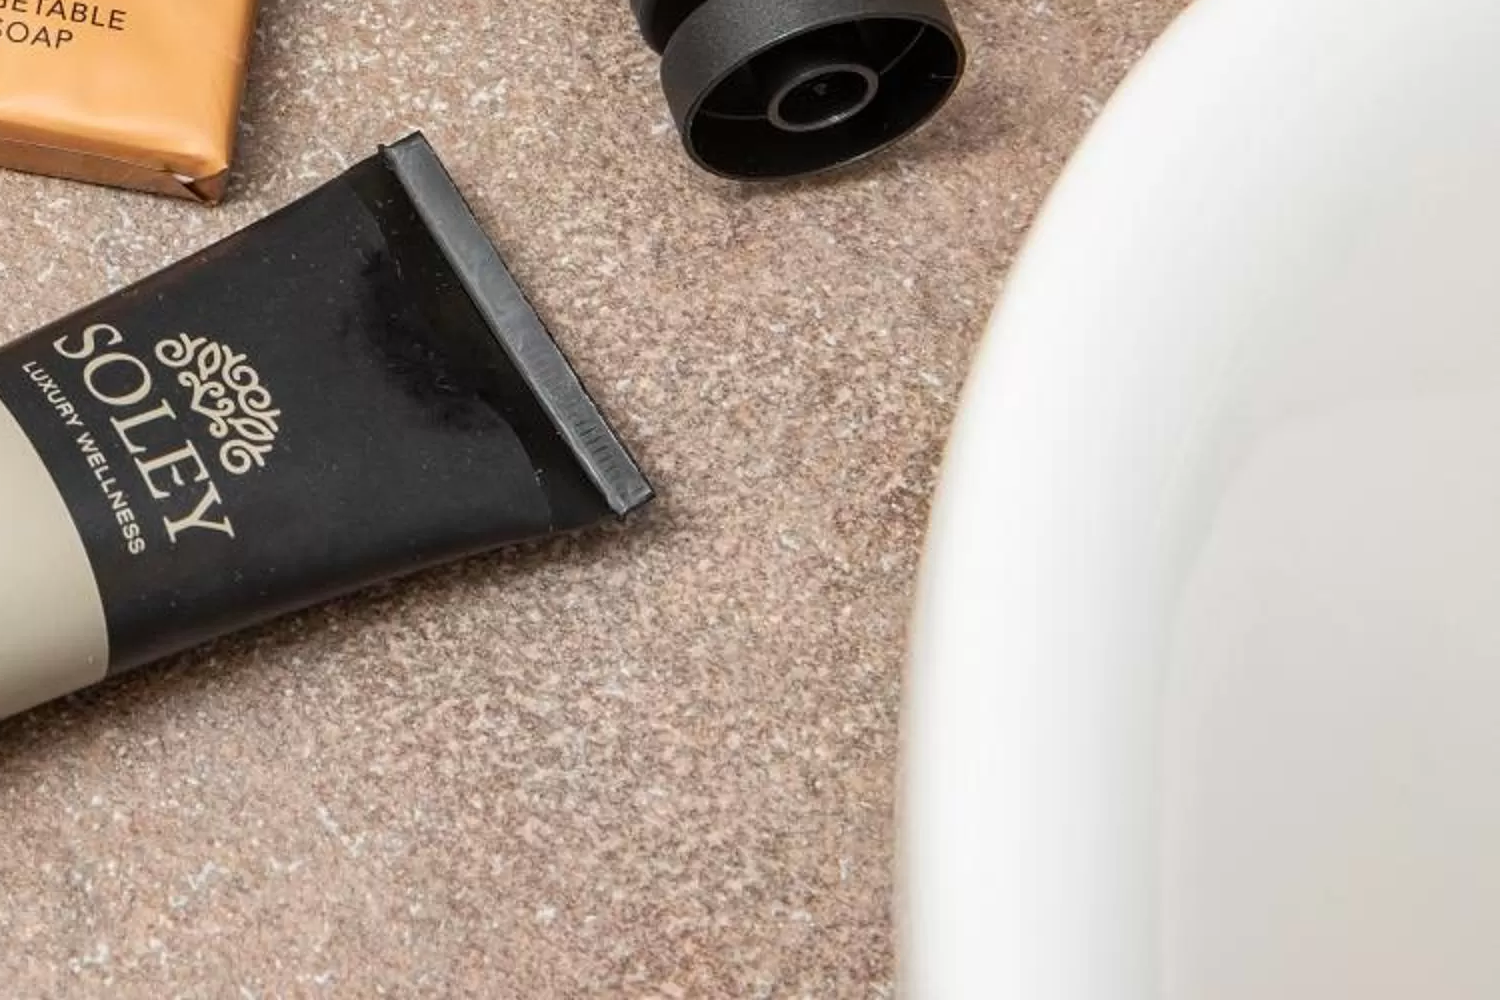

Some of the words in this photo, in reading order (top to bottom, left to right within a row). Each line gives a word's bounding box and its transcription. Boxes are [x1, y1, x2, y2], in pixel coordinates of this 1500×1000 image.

[21, 360, 85, 428] LUXURY
[75, 432, 146, 555] WELLNESS
[53, 323, 235, 543] SOLEY
